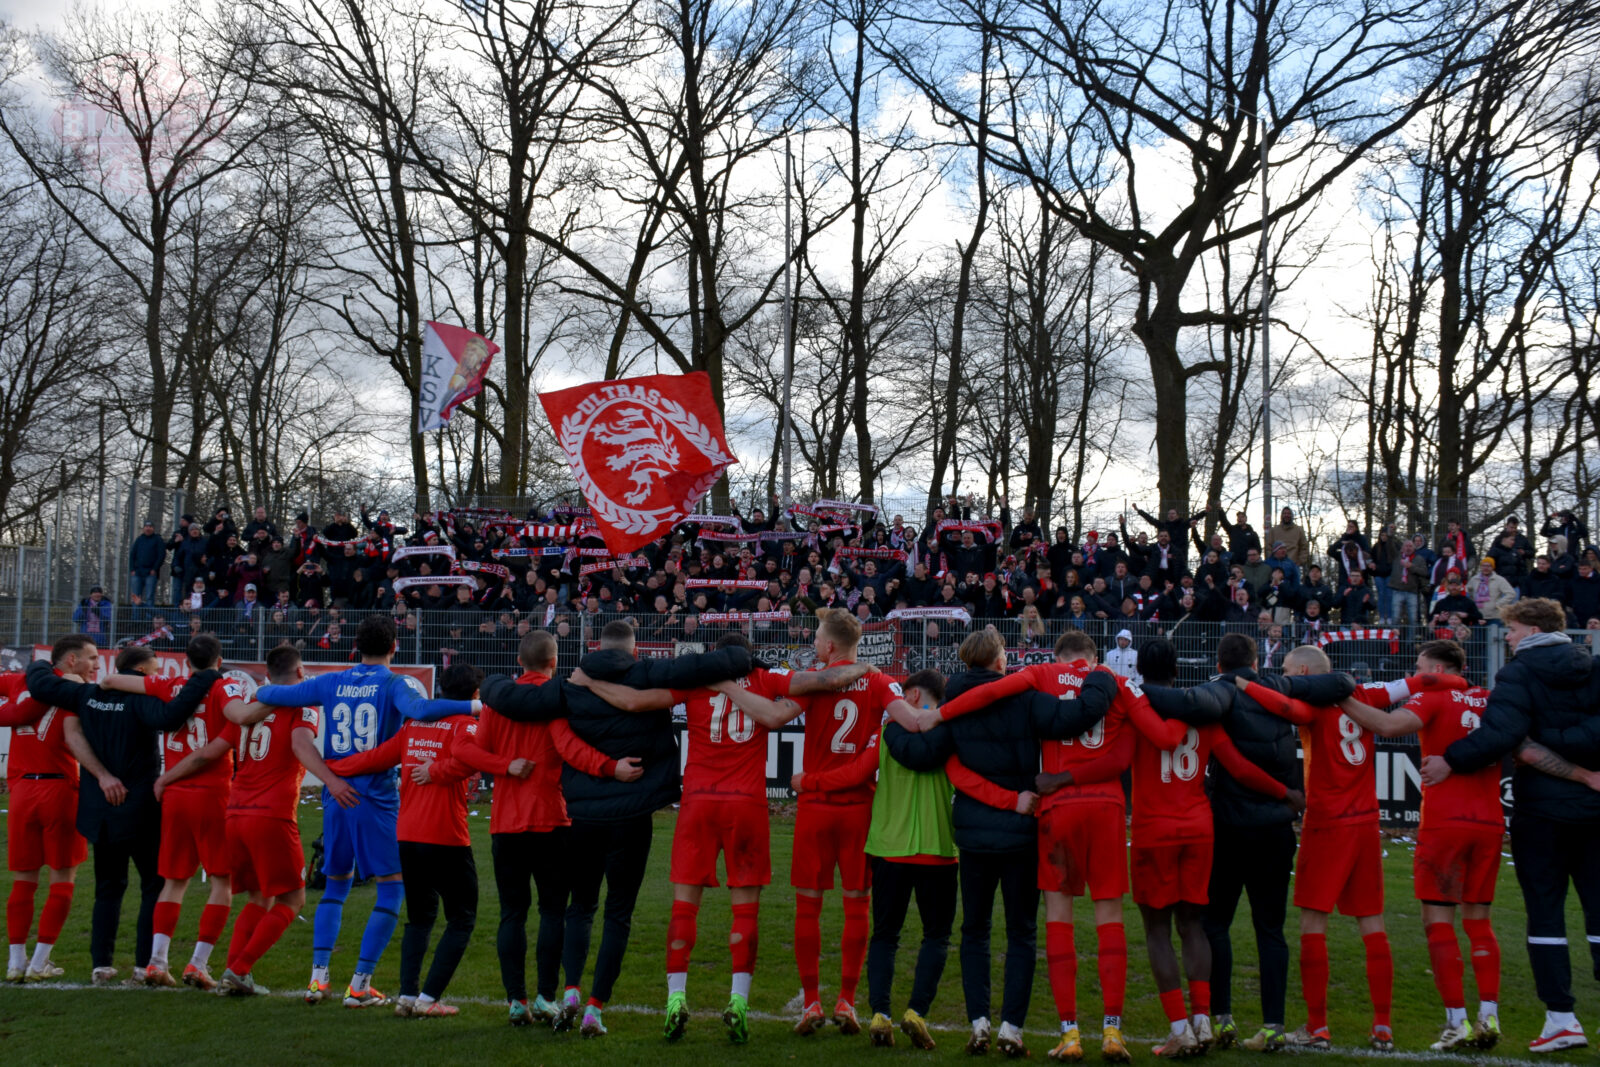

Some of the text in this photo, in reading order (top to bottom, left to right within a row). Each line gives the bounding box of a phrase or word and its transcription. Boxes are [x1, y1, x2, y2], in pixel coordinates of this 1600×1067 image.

[419, 354, 443, 428] KSV
[576, 384, 661, 416] ULTRAS
[336, 685, 379, 698] LANGHOFF
[709, 692, 755, 743] 10
[332, 702, 378, 754] 39
[831, 699, 858, 753] 2
[1338, 713, 1366, 765] 8
[1161, 727, 1200, 784] 18
